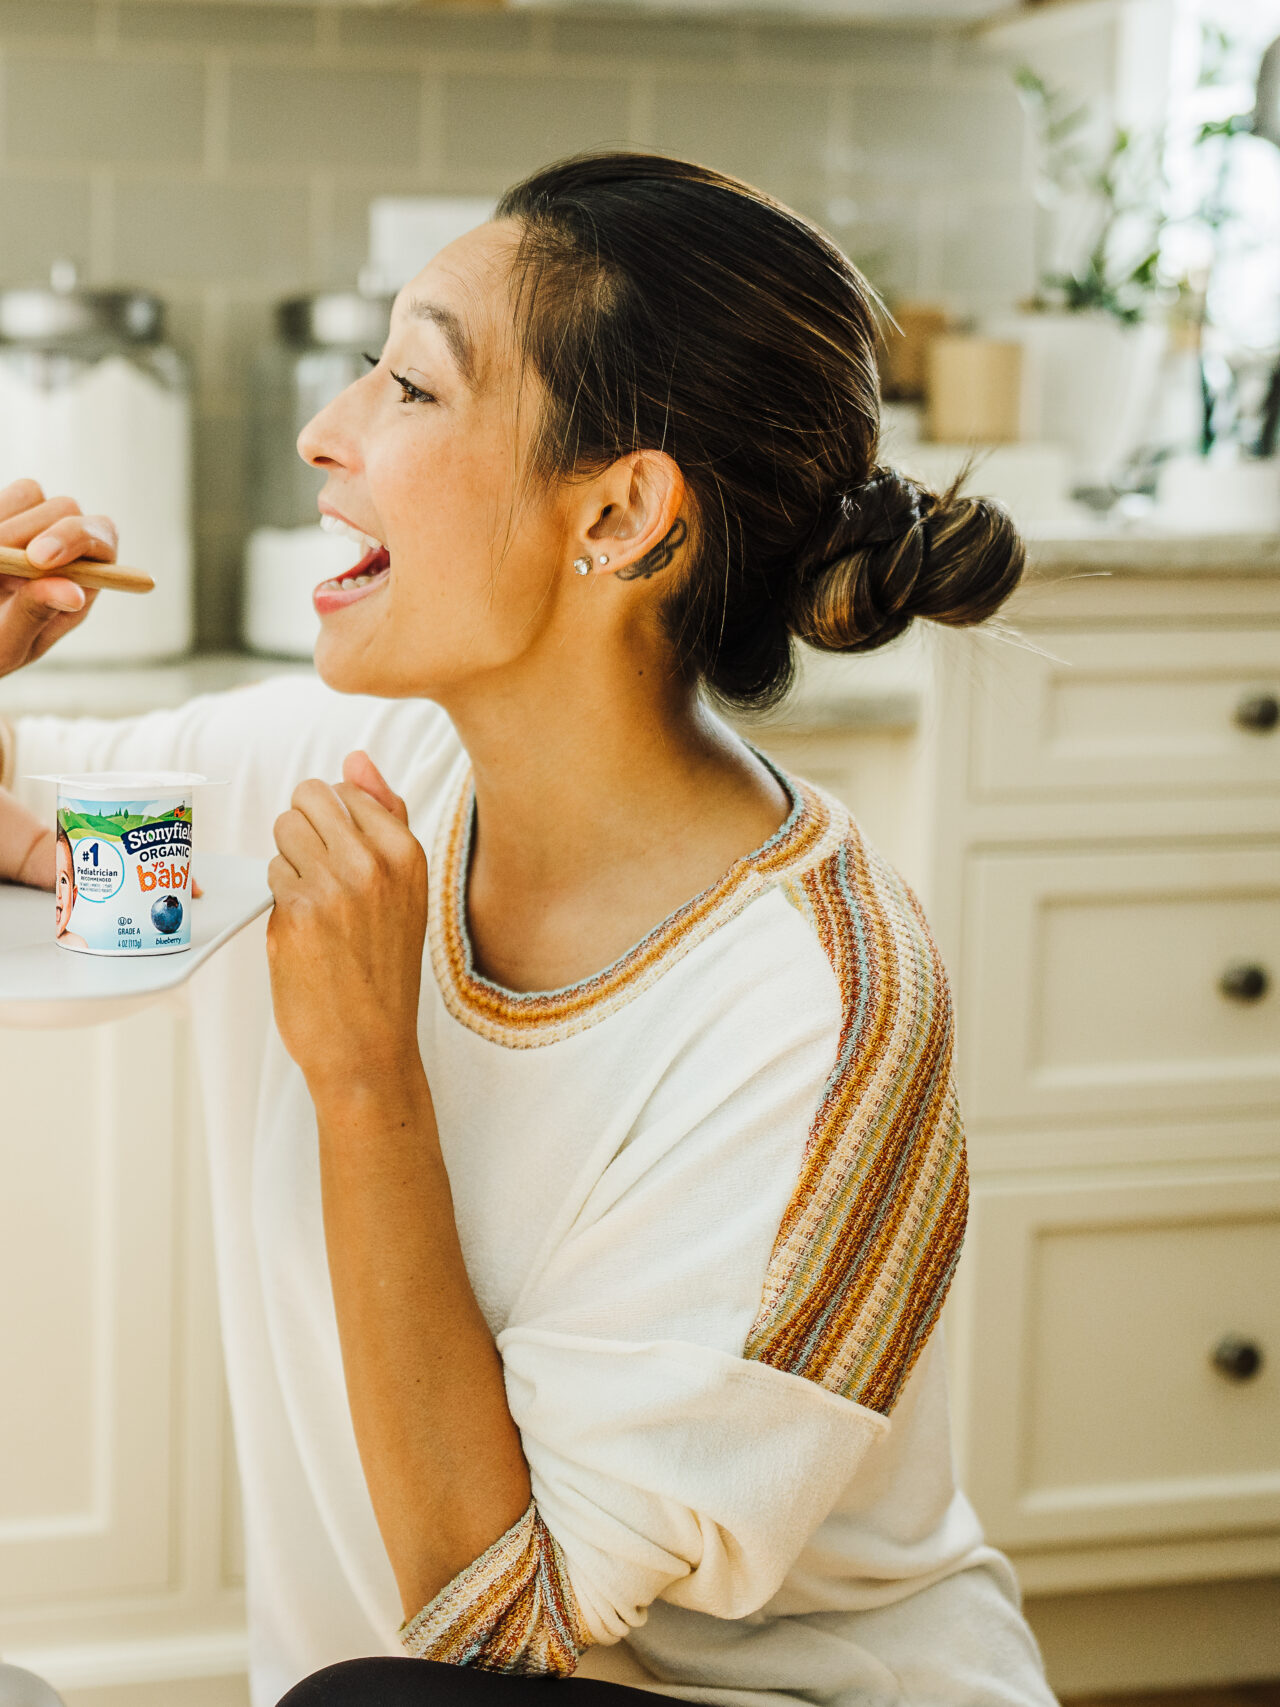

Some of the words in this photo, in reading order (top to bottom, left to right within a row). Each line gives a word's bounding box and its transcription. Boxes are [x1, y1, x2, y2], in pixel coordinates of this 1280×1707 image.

[82, 843, 99, 867] #1
[139, 845, 189, 862] ORGANIC
[152, 861, 165, 872] yo
[77, 867, 118, 877] Pediatrician
[136, 862, 190, 893] baby
[118, 927, 136, 935] GRADE
[122, 940, 128, 948] OZ
[155, 936, 181, 945] blueberry
